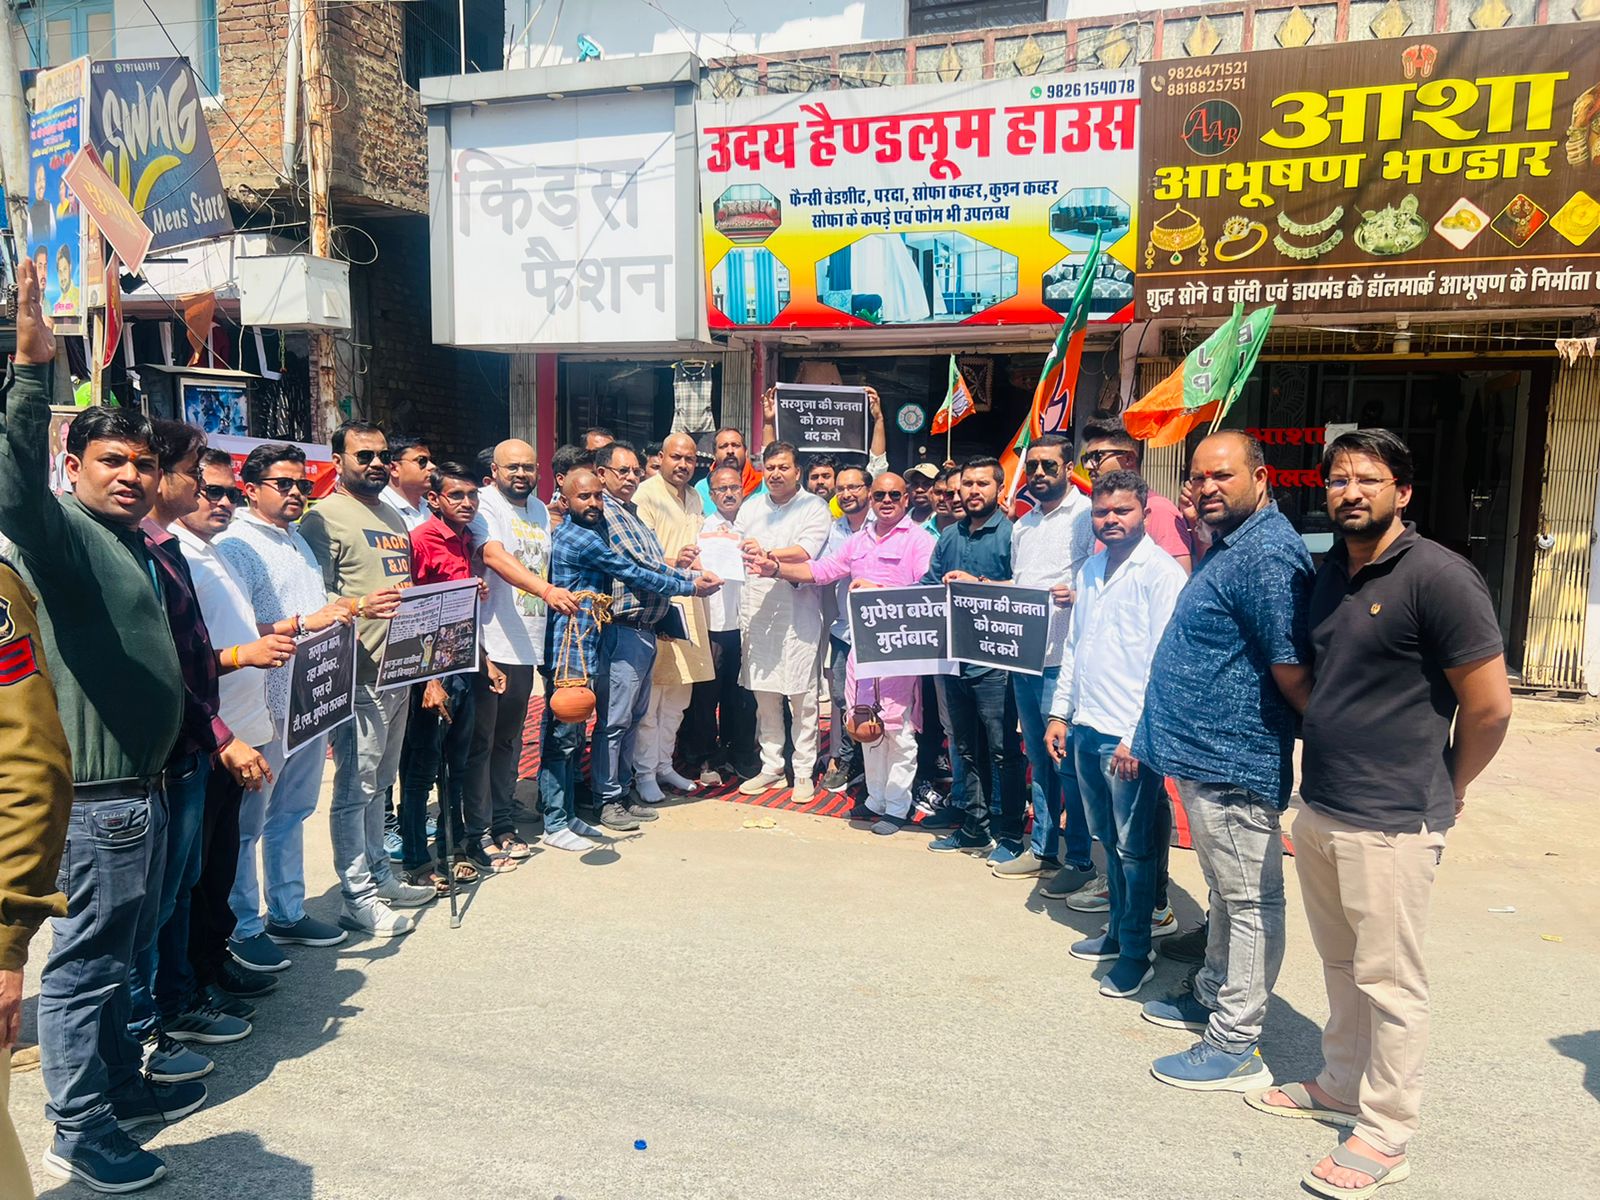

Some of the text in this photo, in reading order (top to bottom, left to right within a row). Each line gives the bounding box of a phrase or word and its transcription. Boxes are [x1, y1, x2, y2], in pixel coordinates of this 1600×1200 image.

[1167, 61, 1248, 80] 9826471521
[1047, 79, 1135, 98] 9826154078
[1167, 77, 1246, 96] 8818825751
[102, 69, 198, 162] SWAG
[1259, 71, 1569, 149] आशा
[703, 98, 1141, 181] उदय हैण्डलूम हाउस
[1180, 108, 1239, 147] AAB
[1153, 140, 1558, 208] आभूषण भण्डार
[912, 182, 947, 201] सोफा
[152, 191, 226, 234] Mens Store
[812, 210, 843, 228] सोफा
[846, 208, 858, 227] के
[915, 205, 943, 223] फोम
[946, 204, 961, 222] भी
[964, 206, 1010, 221] उपलब्ध
[521, 237, 673, 315] फैशन
[1146, 288, 1175, 312] शुद्ध
[1178, 281, 1209, 305] सोने
[1212, 286, 1225, 304] व
[1227, 279, 1261, 304] चाँदी
[1265, 278, 1289, 302] एवं
[1292, 276, 1345, 301] डायमंड
[1347, 275, 1365, 299] के
[1367, 271, 1436, 297] हॉलमार्क
[1439, 273, 1507, 300] आभूषण
[1510, 267, 1528, 293] के
[1531, 265, 1592, 291] निर्माता
[780, 397, 863, 412] सरगुजा की जनता
[800, 412, 844, 426] को ठगना
[804, 428, 841, 441] बंद करो
[860, 596, 948, 627] भुपेश बघेल
[953, 595, 1046, 617] सरगुजा की जनता
[974, 615, 1023, 636] को ठगना
[876, 625, 938, 653] मुर्दाबाद
[979, 637, 1019, 657] बंद करो
